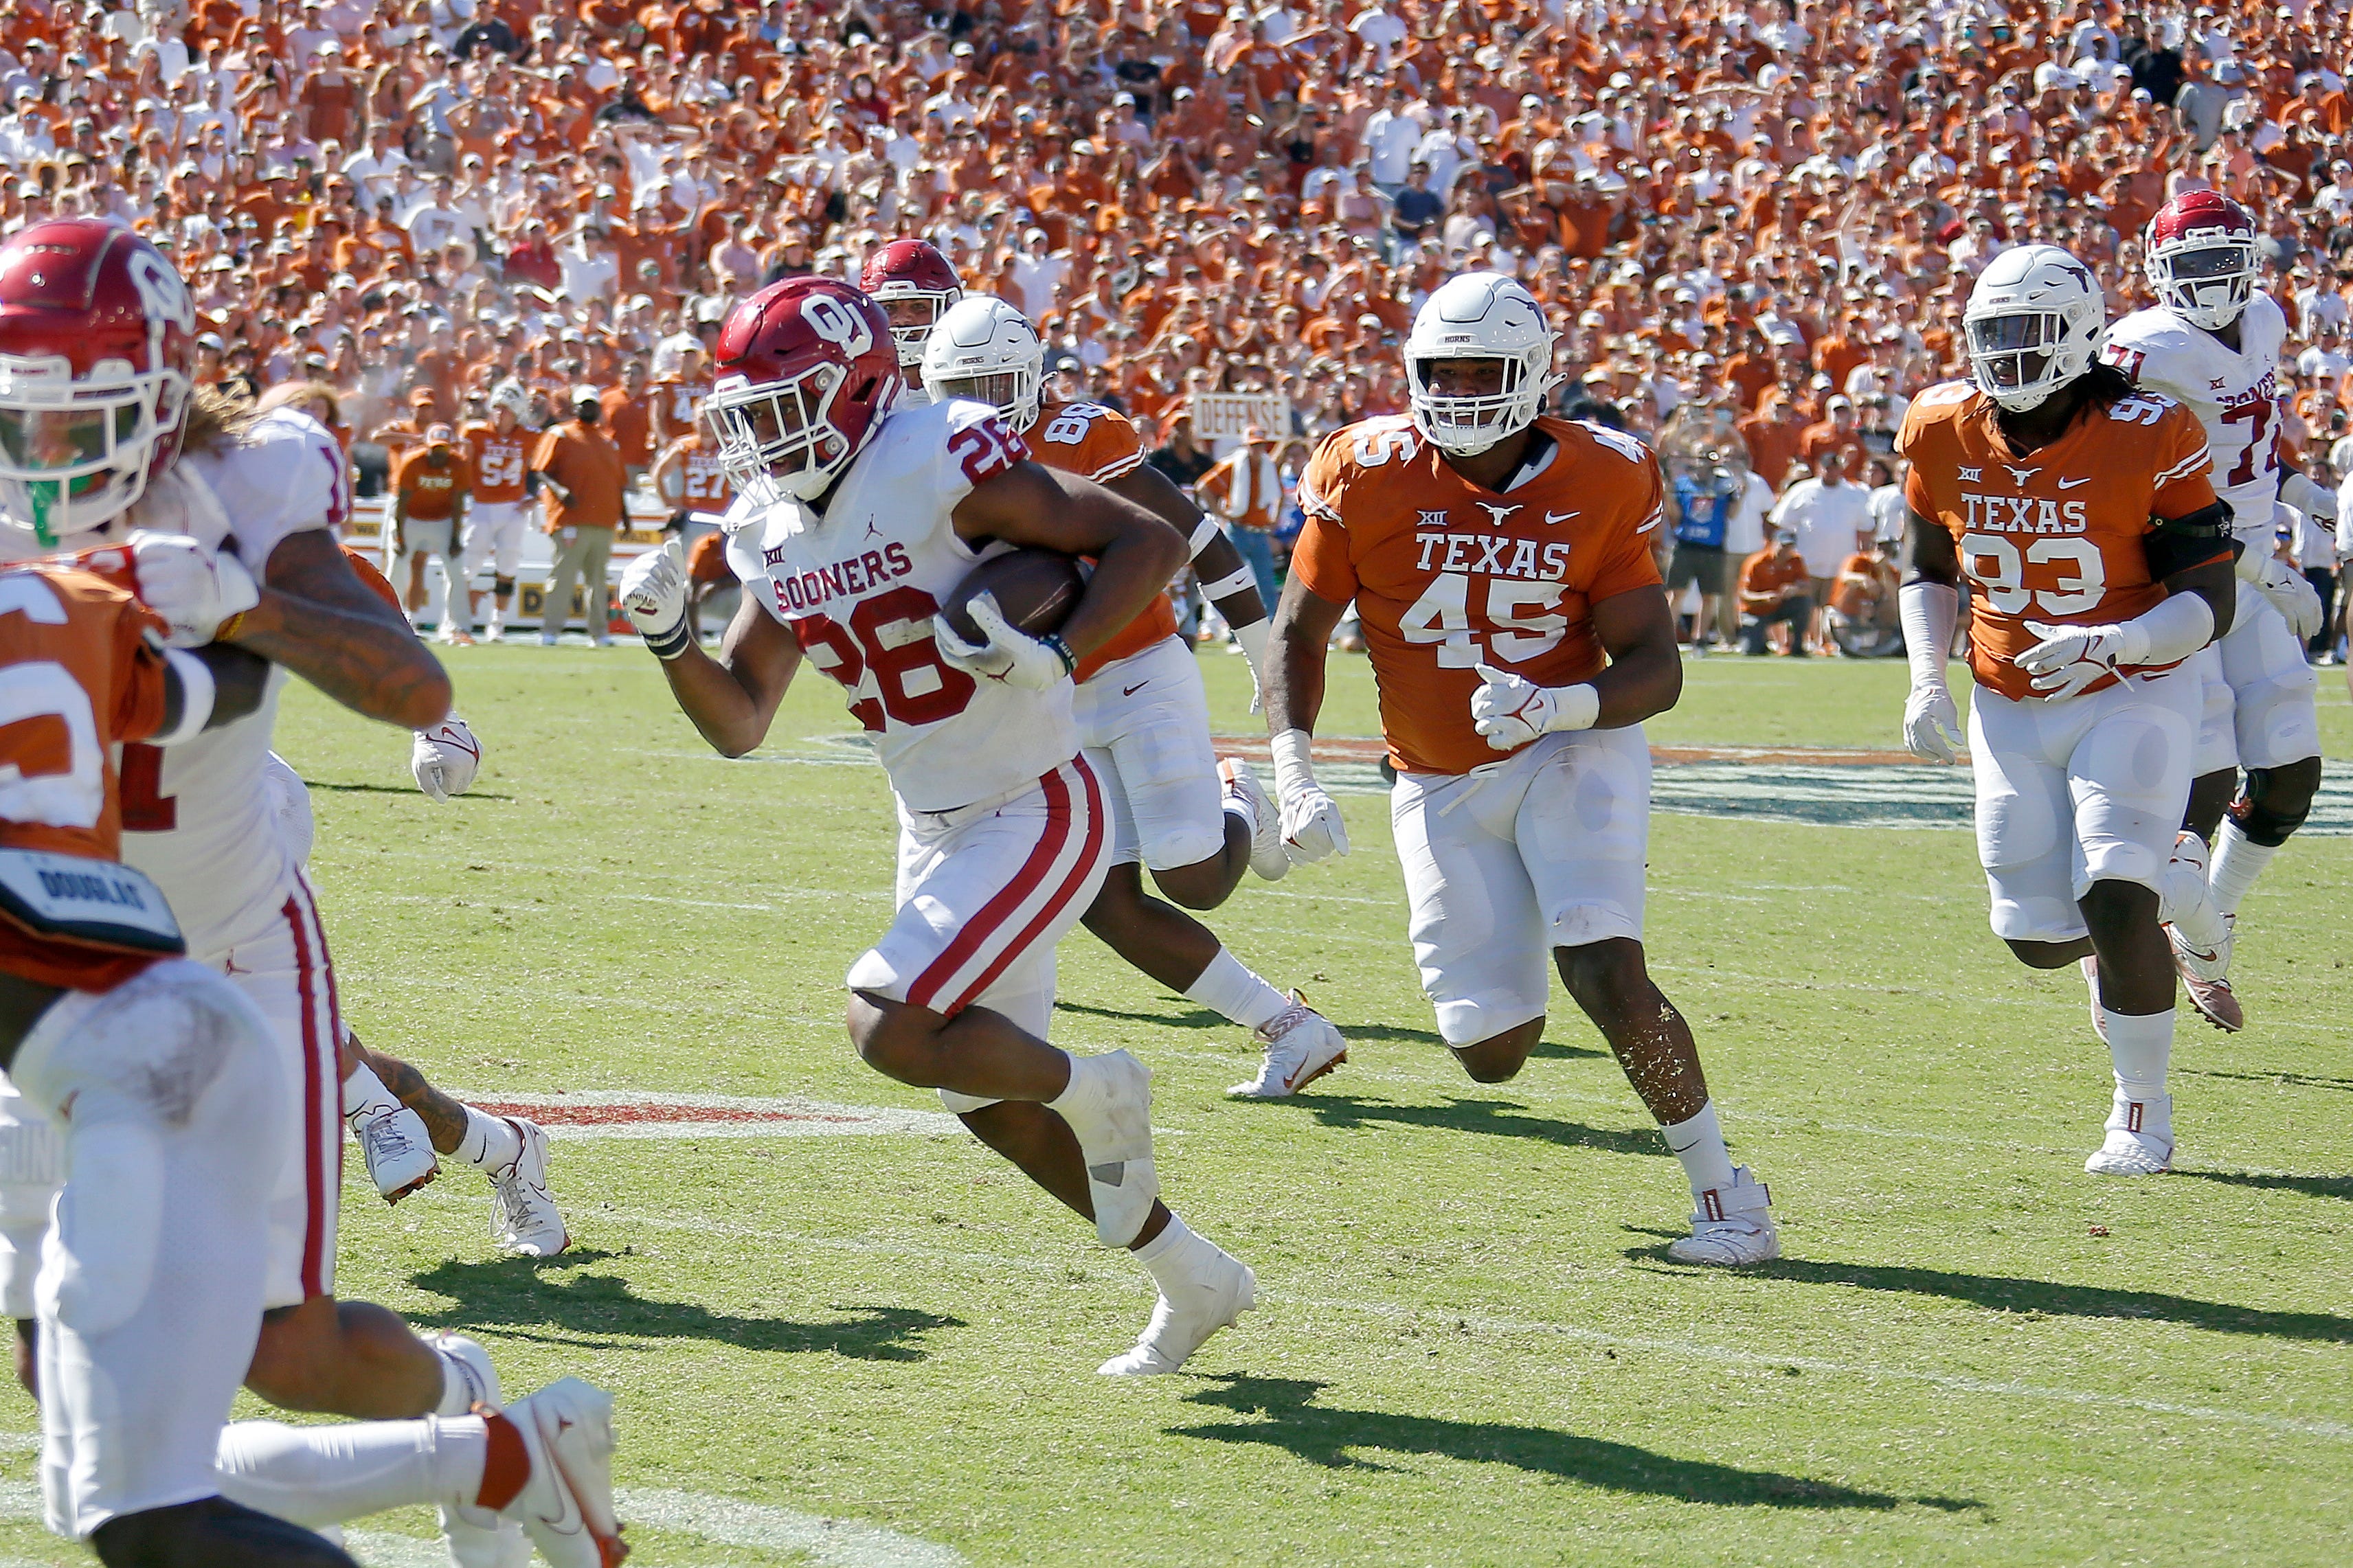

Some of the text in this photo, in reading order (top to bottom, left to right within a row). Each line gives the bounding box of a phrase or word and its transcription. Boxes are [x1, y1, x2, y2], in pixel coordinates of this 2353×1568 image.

[800, 293, 873, 360] OU
[962, 356, 984, 364] HORNS
[1202, 398, 1283, 434] DEFENSE
[481, 456, 523, 486] 54
[947, 417, 1032, 485] 26
[686, 468, 727, 498] 27
[1958, 466, 1983, 483] XII
[1417, 510, 1448, 525] XII
[1961, 493, 2087, 534] TEXAS
[763, 545, 785, 566] XII
[1416, 533, 1570, 580] TEXAS
[1960, 533, 2107, 615] 93
[774, 542, 912, 613] SOONERS
[1398, 571, 1569, 668] 45
[790, 584, 977, 734] 26
[37, 870, 147, 911] DOUGLAS
